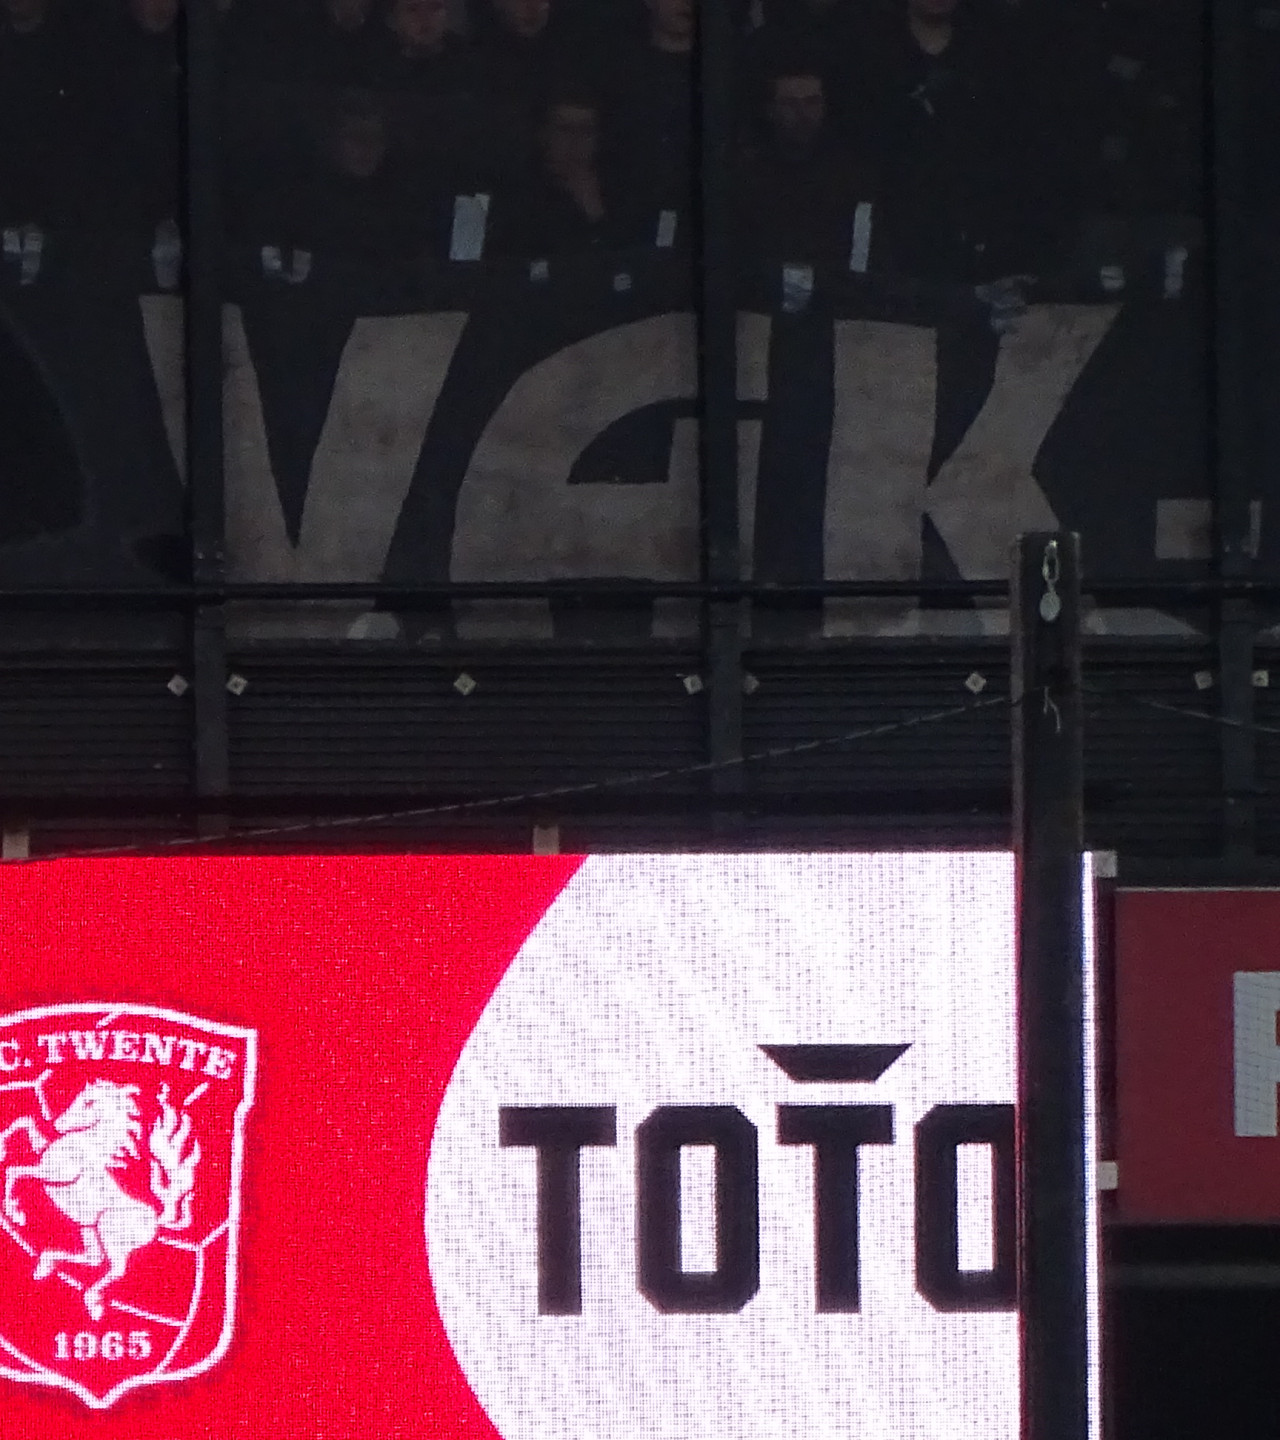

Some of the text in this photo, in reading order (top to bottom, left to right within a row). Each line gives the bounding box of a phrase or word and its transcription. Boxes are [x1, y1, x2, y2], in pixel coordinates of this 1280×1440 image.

[37, 1029, 237, 1080] TWENTE
[498, 1103, 1020, 1316] TOTO
[53, 1330, 153, 1361] 1965
